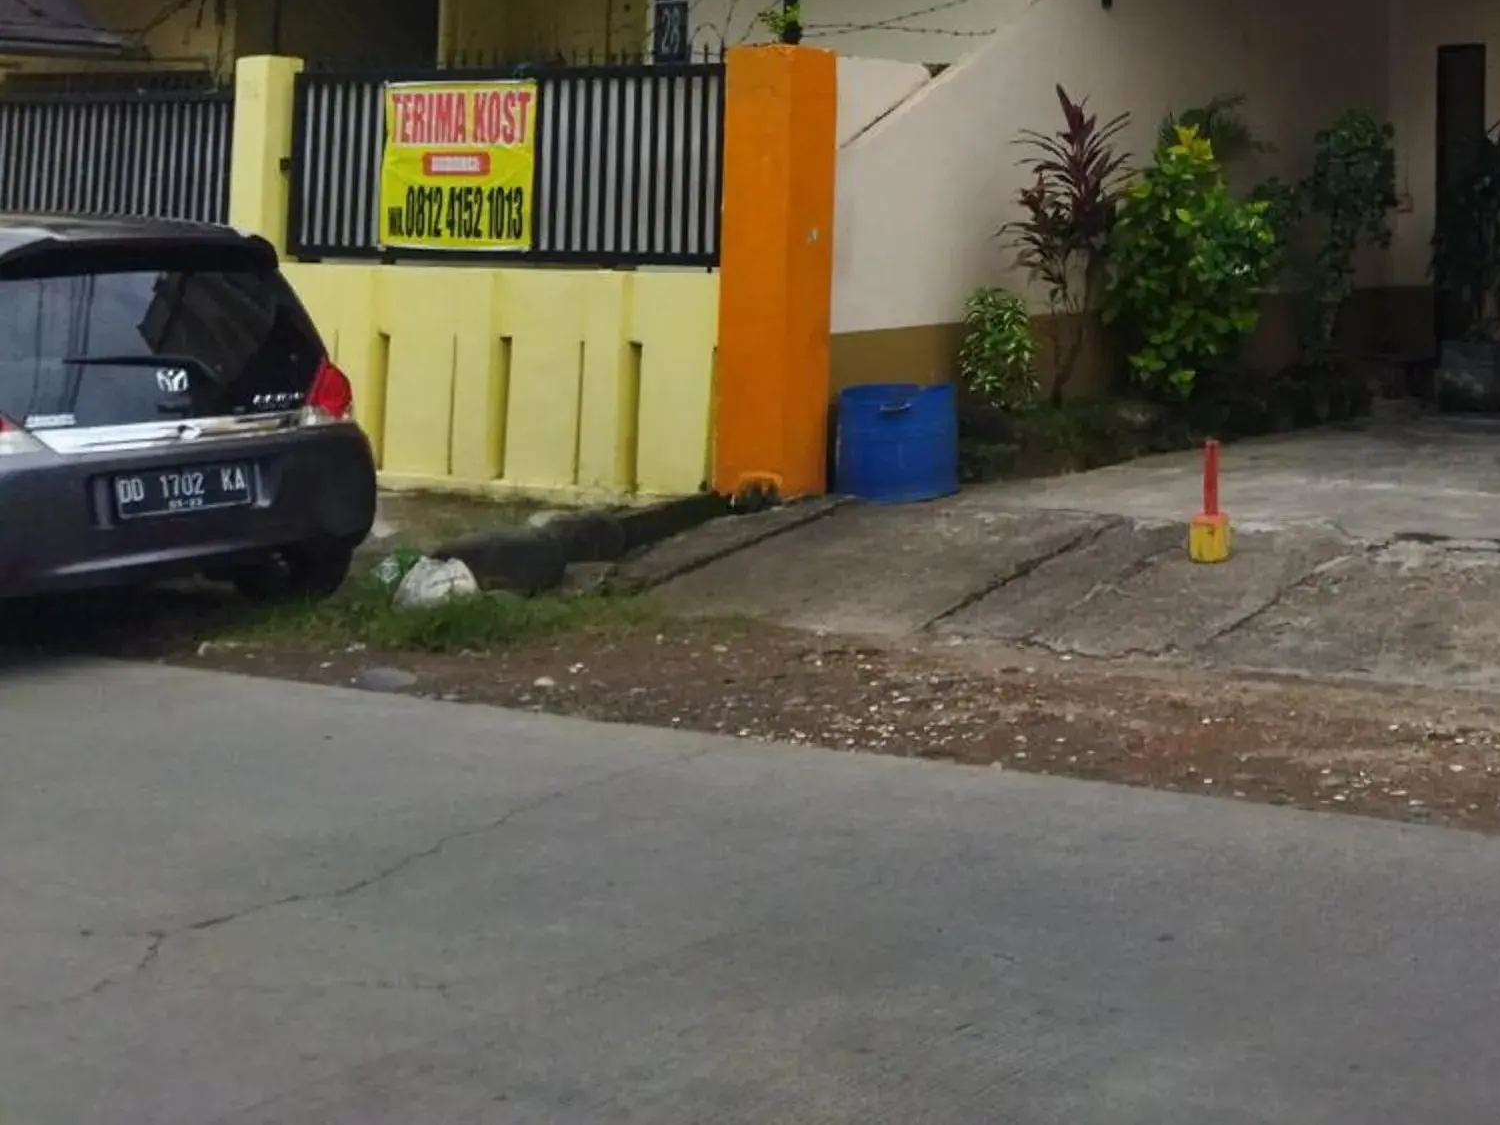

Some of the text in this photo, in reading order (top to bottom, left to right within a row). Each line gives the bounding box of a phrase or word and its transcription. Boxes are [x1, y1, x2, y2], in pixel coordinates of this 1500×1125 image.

[661, 7, 680, 53] 28
[391, 90, 531, 144] TERIMA KOST
[405, 185, 442, 238] 0812
[446, 186, 483, 238] 4152
[487, 186, 523, 239] 1013
[117, 467, 245, 504] DD 1702 KA
